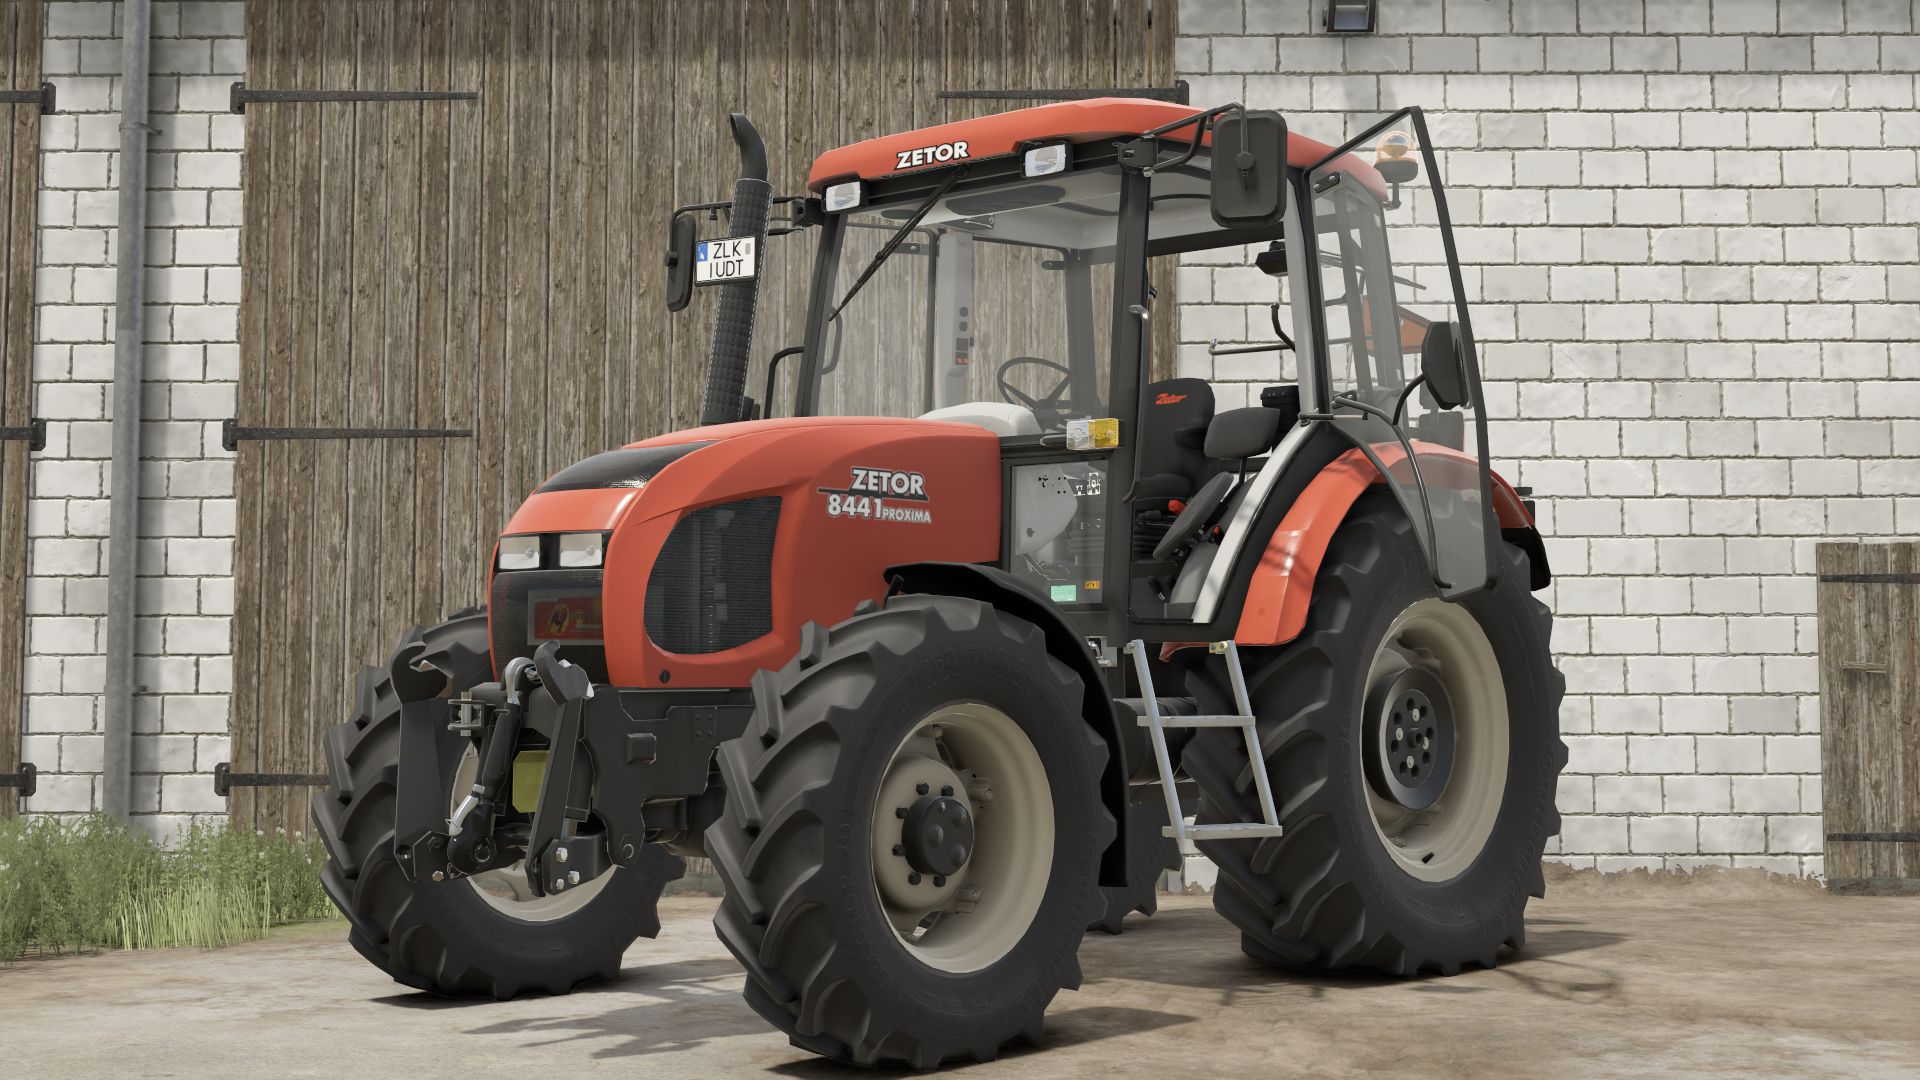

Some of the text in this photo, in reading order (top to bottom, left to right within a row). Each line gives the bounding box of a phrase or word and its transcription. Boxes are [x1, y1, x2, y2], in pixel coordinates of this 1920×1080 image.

[894, 140, 971, 170] ZETOR
[712, 240, 742, 259] ZLK
[851, 467, 925, 497] ZETOR
[827, 492, 932, 524] 8441 PROXIMA
